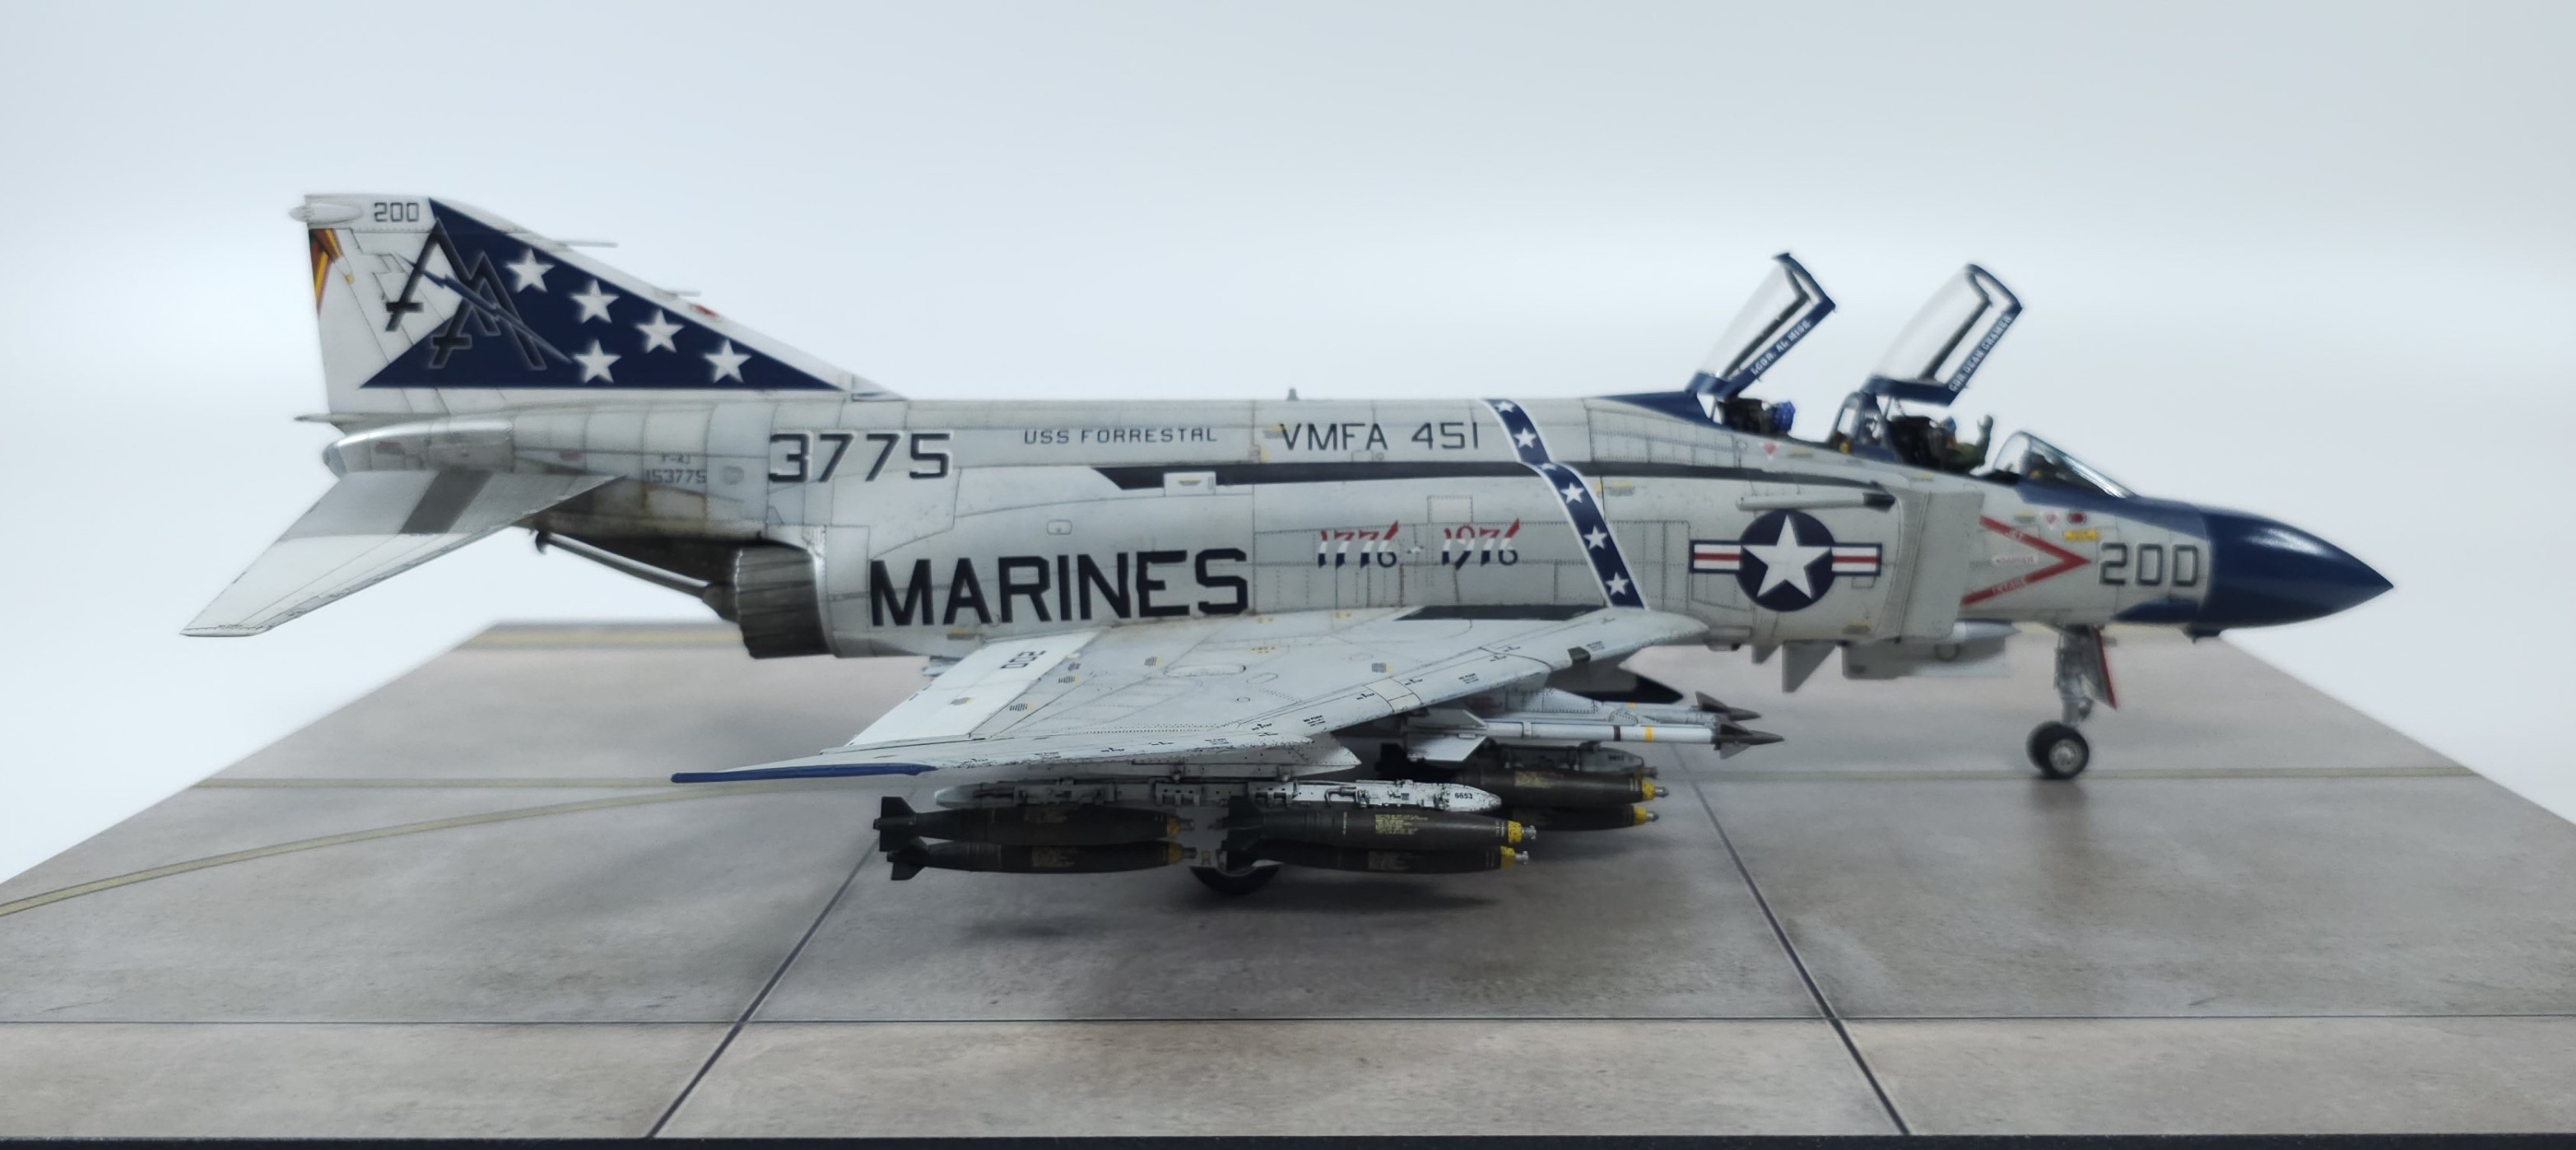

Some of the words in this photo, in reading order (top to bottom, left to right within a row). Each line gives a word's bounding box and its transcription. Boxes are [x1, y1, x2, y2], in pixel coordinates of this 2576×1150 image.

[374, 202, 420, 222] 200
[1024, 429, 1070, 445] USS
[1080, 427, 1218, 444] FORRESTAL
[1279, 422, 1388, 451] VMFA
[1411, 421, 1478, 450] 451
[644, 468, 706, 484] 153775
[767, 431, 955, 484] 3775
[1317, 519, 1399, 570] 1776
[1441, 517, 1518, 572] 1976
[2099, 542, 2200, 588] 200
[869, 547, 1249, 627] MARINES
